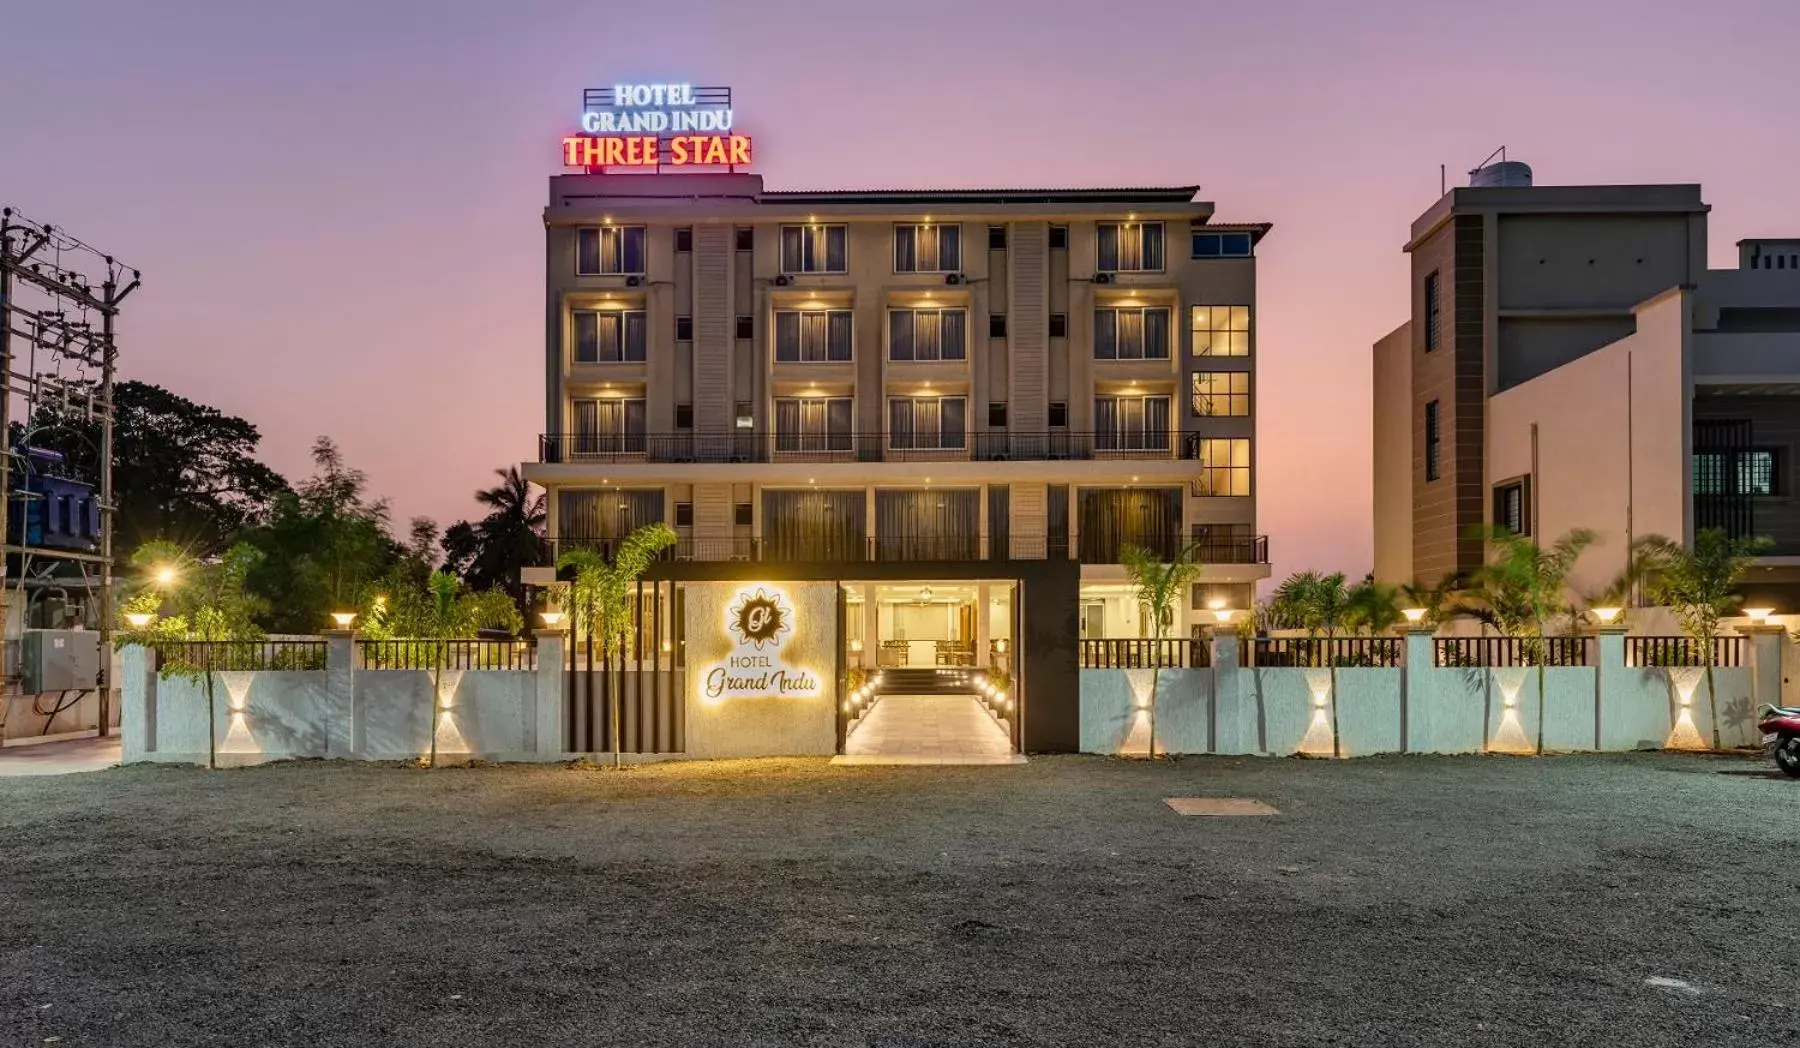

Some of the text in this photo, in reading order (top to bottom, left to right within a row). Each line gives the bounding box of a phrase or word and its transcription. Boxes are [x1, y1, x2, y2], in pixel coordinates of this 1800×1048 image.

[614, 84, 696, 106] HOTEL
[582, 110, 732, 132] GRAND INDU
[563, 136, 751, 165] THREE STAR
[730, 656, 772, 668] HOTEL
[706, 667, 816, 698] Grand Indu
